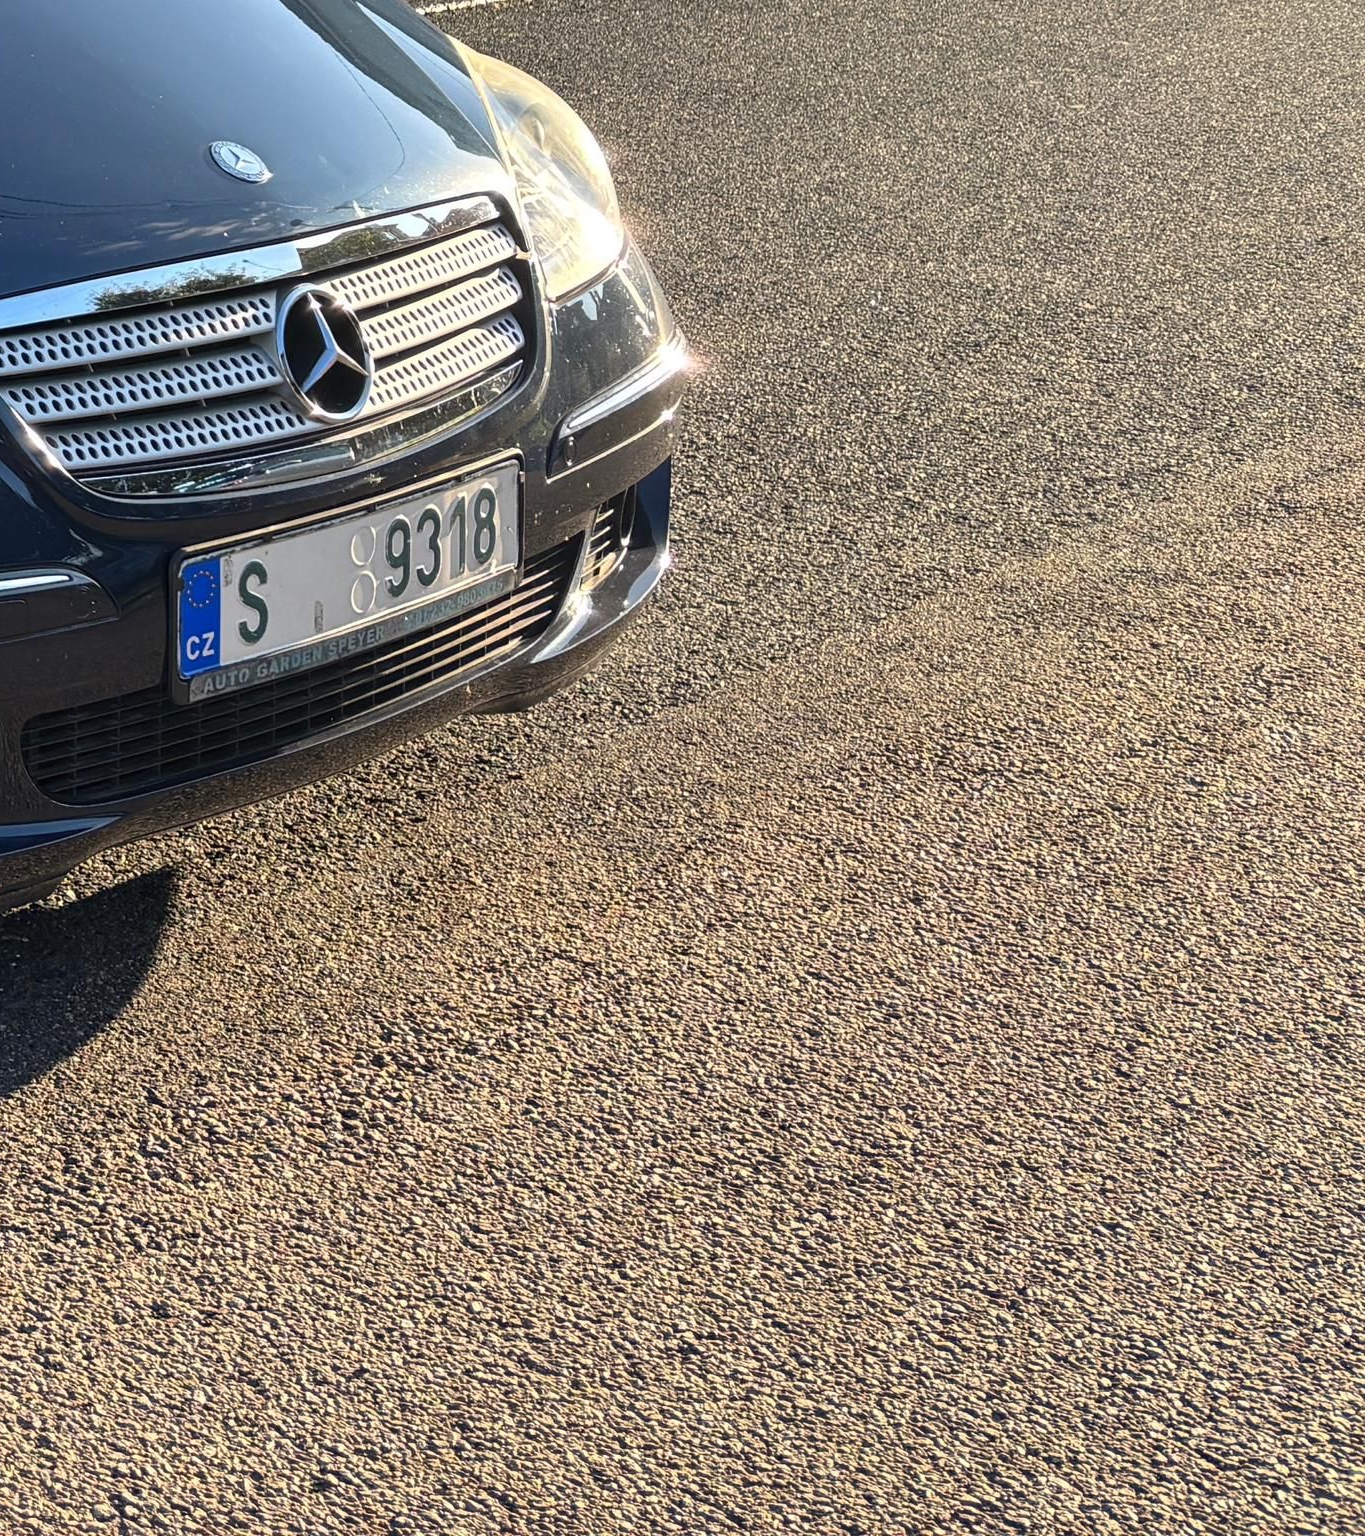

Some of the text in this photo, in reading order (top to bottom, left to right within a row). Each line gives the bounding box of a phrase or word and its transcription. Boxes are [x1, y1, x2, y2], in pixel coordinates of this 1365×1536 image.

[384, 482, 498, 598] 9318
[185, 631, 216, 661] CZ
[203, 668, 251, 695] AUTO
[256, 646, 324, 678] GARDEN
[329, 624, 385, 656] SPEYER
